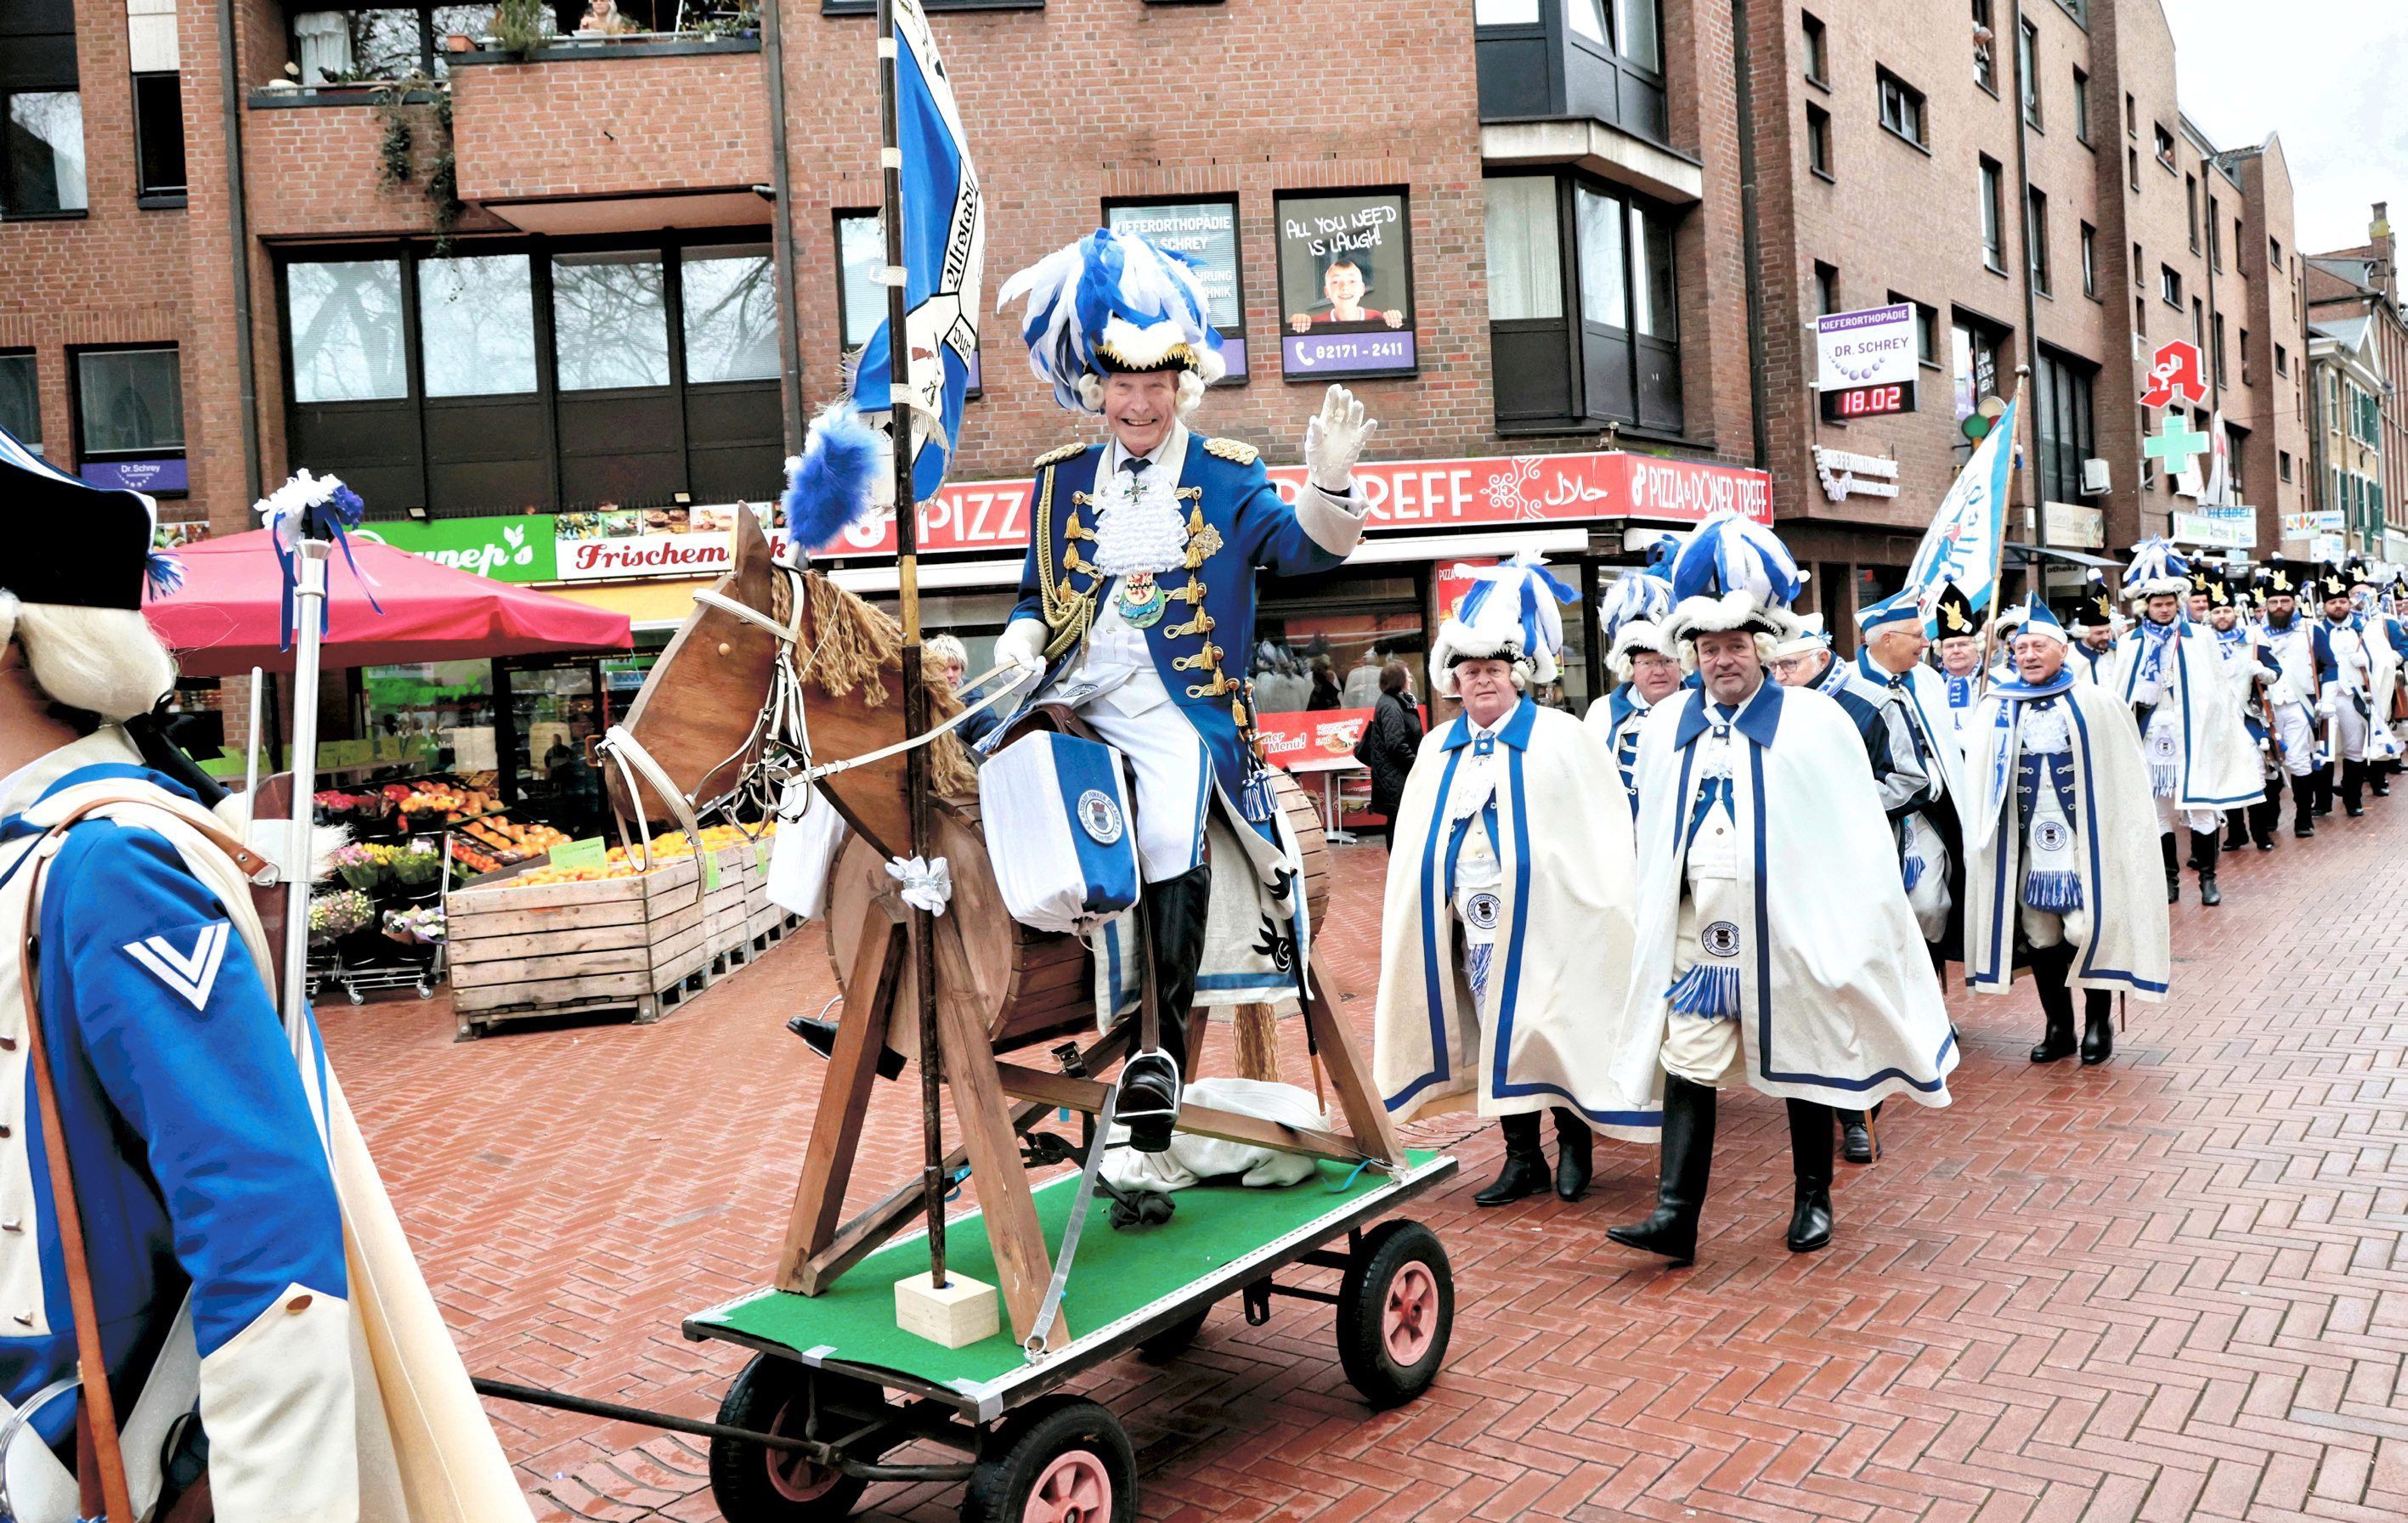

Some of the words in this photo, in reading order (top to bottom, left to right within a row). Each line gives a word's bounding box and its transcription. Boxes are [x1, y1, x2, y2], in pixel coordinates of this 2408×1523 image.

[946, 179, 975, 290] Altstadt
[1286, 218, 1312, 240] ALL
[1314, 215, 1347, 235] YOU
[1351, 205, 1397, 229] NEED
[1160, 237, 1209, 251] SCHREY
[1308, 239, 1326, 256] IS
[1330, 223, 1382, 253] LAUGH!
[1820, 308, 1908, 331] KIEFERORTHOPÄDIE
[1371, 342, 1403, 358] 2411
[1834, 345, 1855, 358] DR.
[1858, 337, 1909, 354] SCHREY
[1842, 386, 1902, 415] 18.02
[121, 465, 133, 474] Dr.
[133, 464, 161, 473] Schrey
[1364, 470, 1473, 521] REFF
[1649, 466, 1686, 510] PIZZA
[1691, 470, 1736, 516] DÖNER
[1735, 478, 1767, 516] TREFF
[916, 490, 1031, 544] PIZZ
[1269, 732, 1307, 753] Menü!
